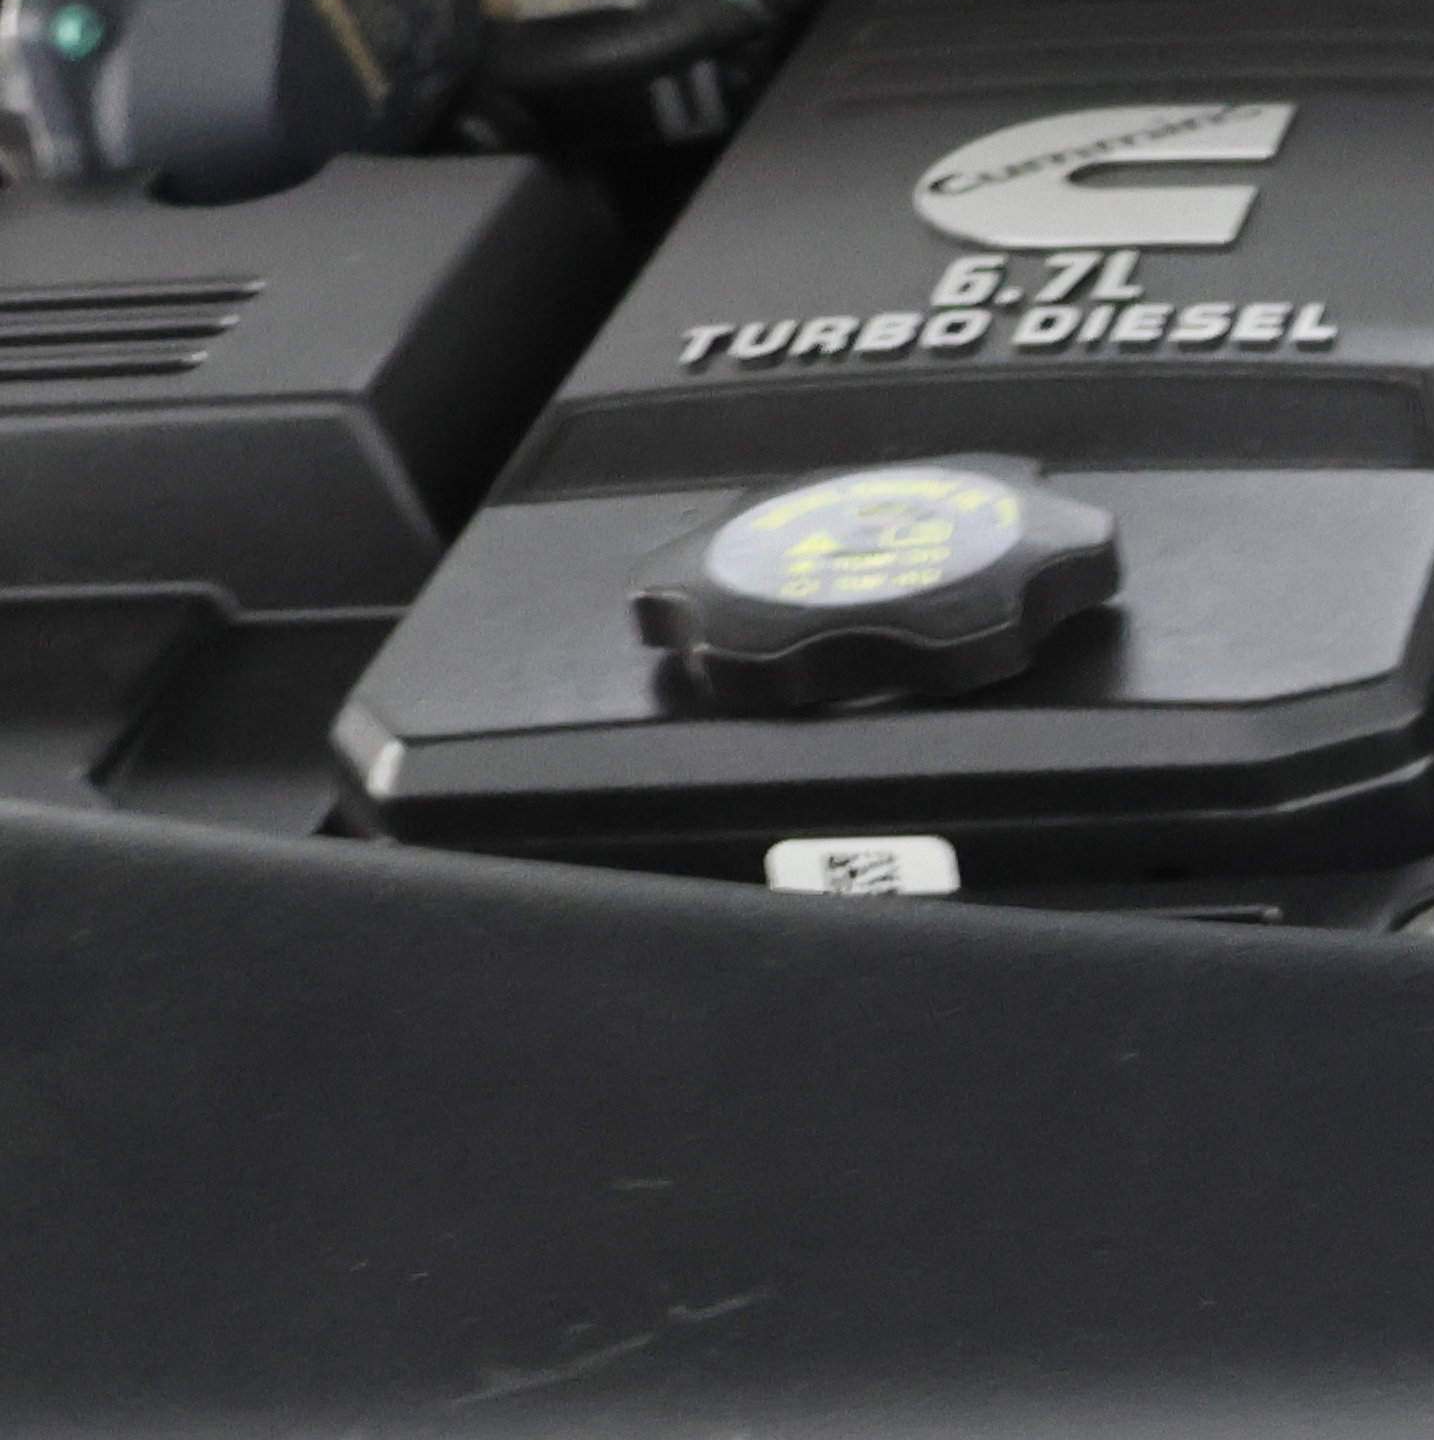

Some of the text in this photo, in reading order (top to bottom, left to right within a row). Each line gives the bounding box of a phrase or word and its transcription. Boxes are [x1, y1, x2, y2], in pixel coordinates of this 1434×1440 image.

[930, 249, 1145, 308] 6.7L
[680, 301, 1339, 363] TURBO DIESEL
